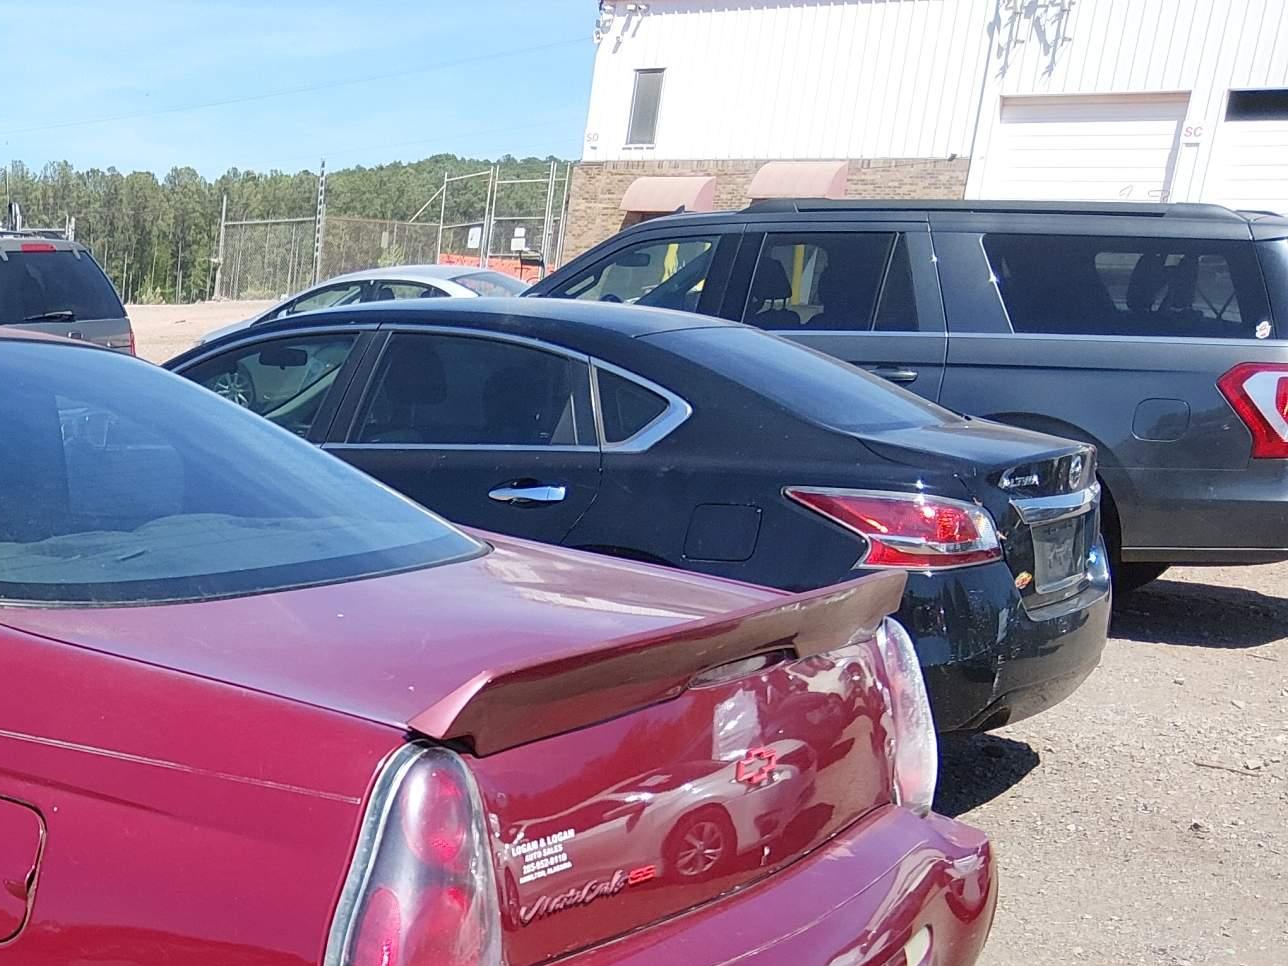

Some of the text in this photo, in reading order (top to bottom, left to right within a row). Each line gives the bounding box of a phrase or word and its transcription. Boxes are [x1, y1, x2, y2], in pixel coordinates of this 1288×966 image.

[1184, 126, 1203, 137] SC
[512, 828, 575, 857] LOGAN & LOGAN
[524, 844, 563, 862] AUTO SALES
[627, 864, 657, 885] SS
